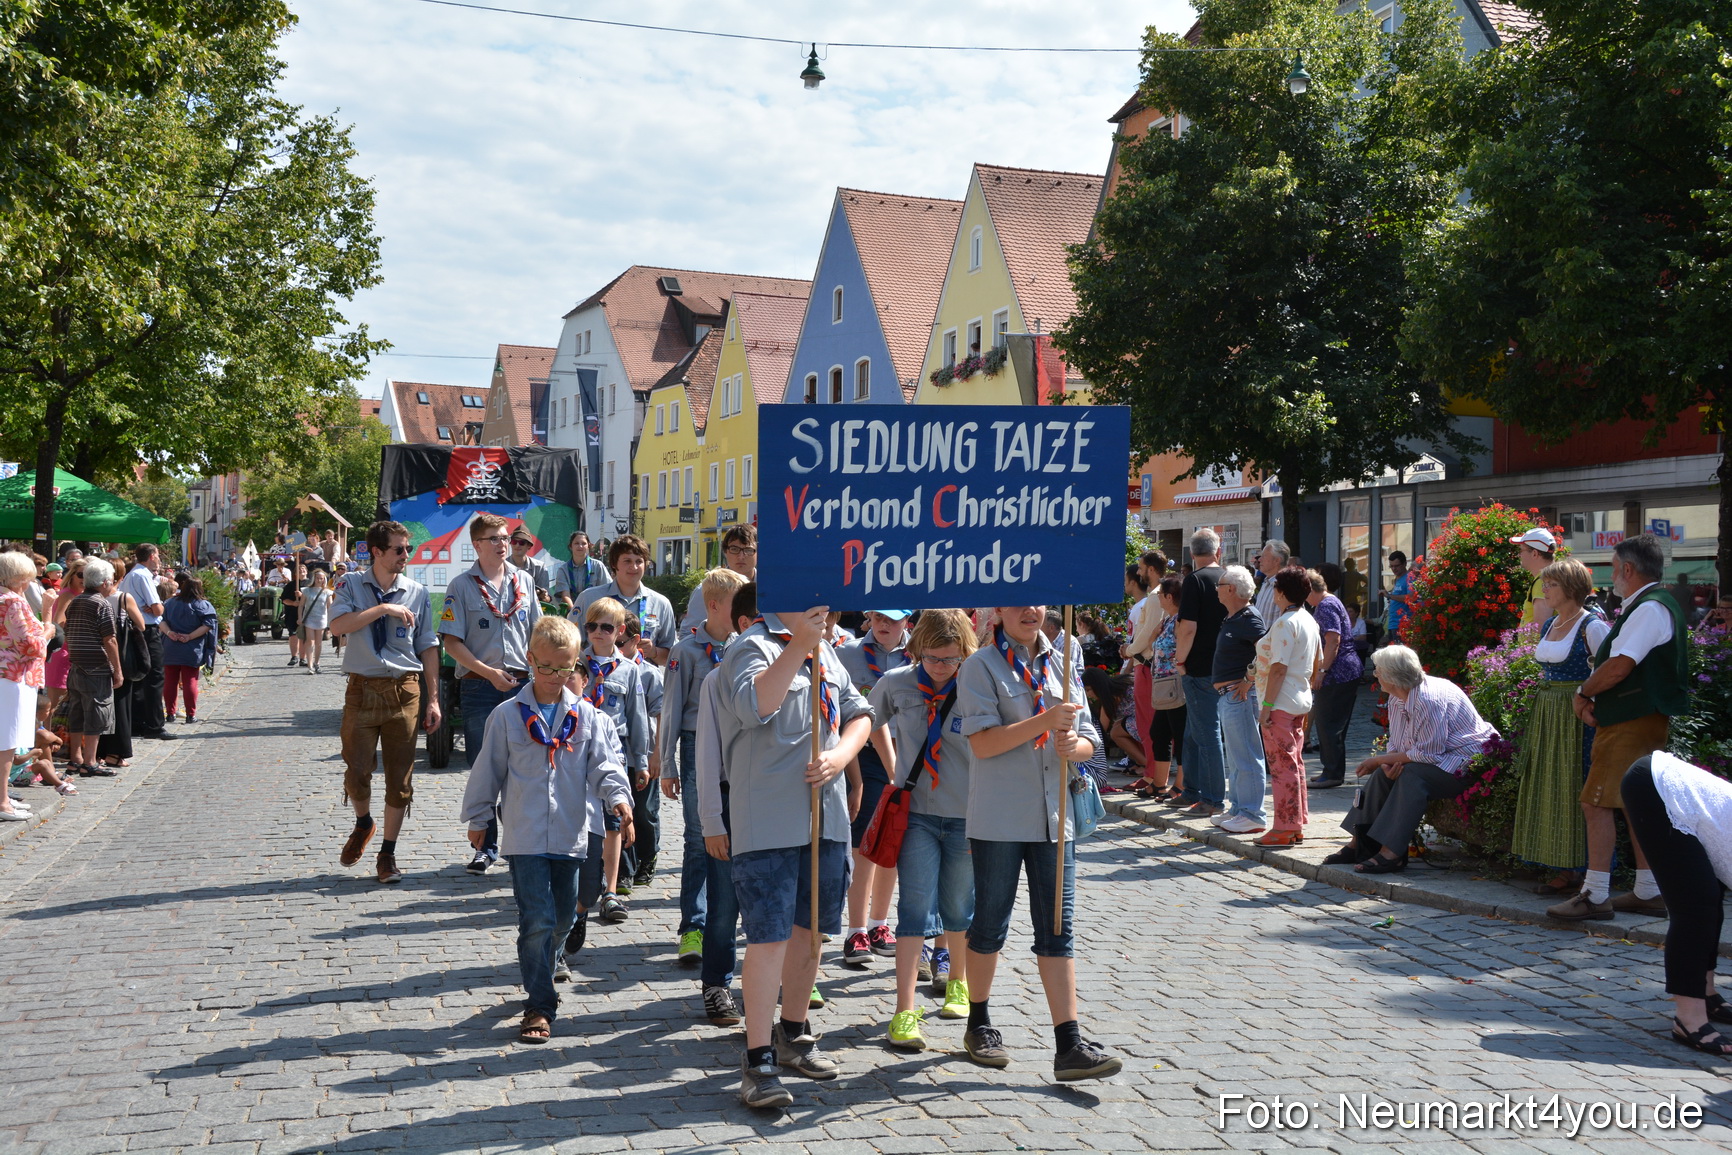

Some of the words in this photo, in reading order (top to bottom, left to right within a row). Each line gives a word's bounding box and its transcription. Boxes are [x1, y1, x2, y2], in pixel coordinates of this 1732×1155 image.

[662, 450, 679, 466] HOTEL
[788, 417, 978, 474] SIEDLUNG
[990, 410, 1096, 473] TAIZÉ
[784, 484, 922, 532] Verband
[933, 484, 1112, 528] Christlicher
[1143, 477, 1150, 502] P
[842, 539, 1041, 595] Pfadfinder
